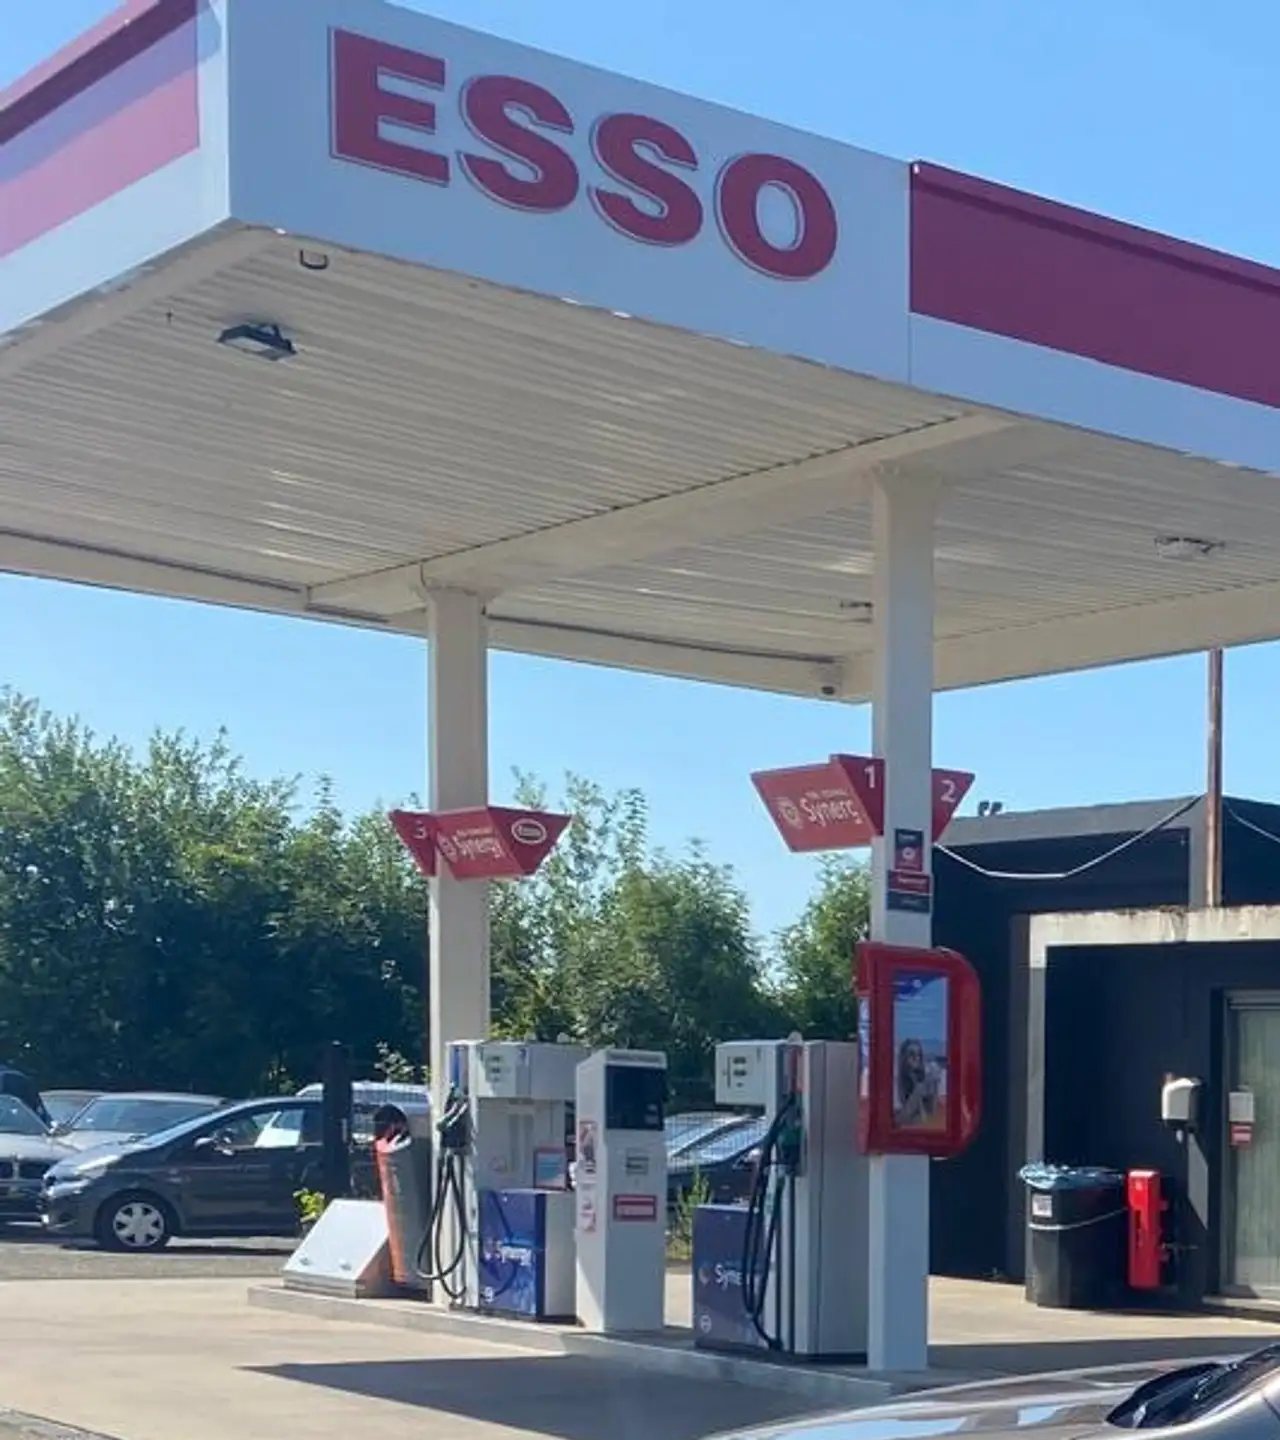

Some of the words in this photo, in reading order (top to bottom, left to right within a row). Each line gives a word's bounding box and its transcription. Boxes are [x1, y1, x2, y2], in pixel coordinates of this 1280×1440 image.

[327, 26, 838, 282] ESSO
[864, 764, 876, 789] 1
[940, 779, 957, 803] 2
[413, 819, 428, 840] 3
